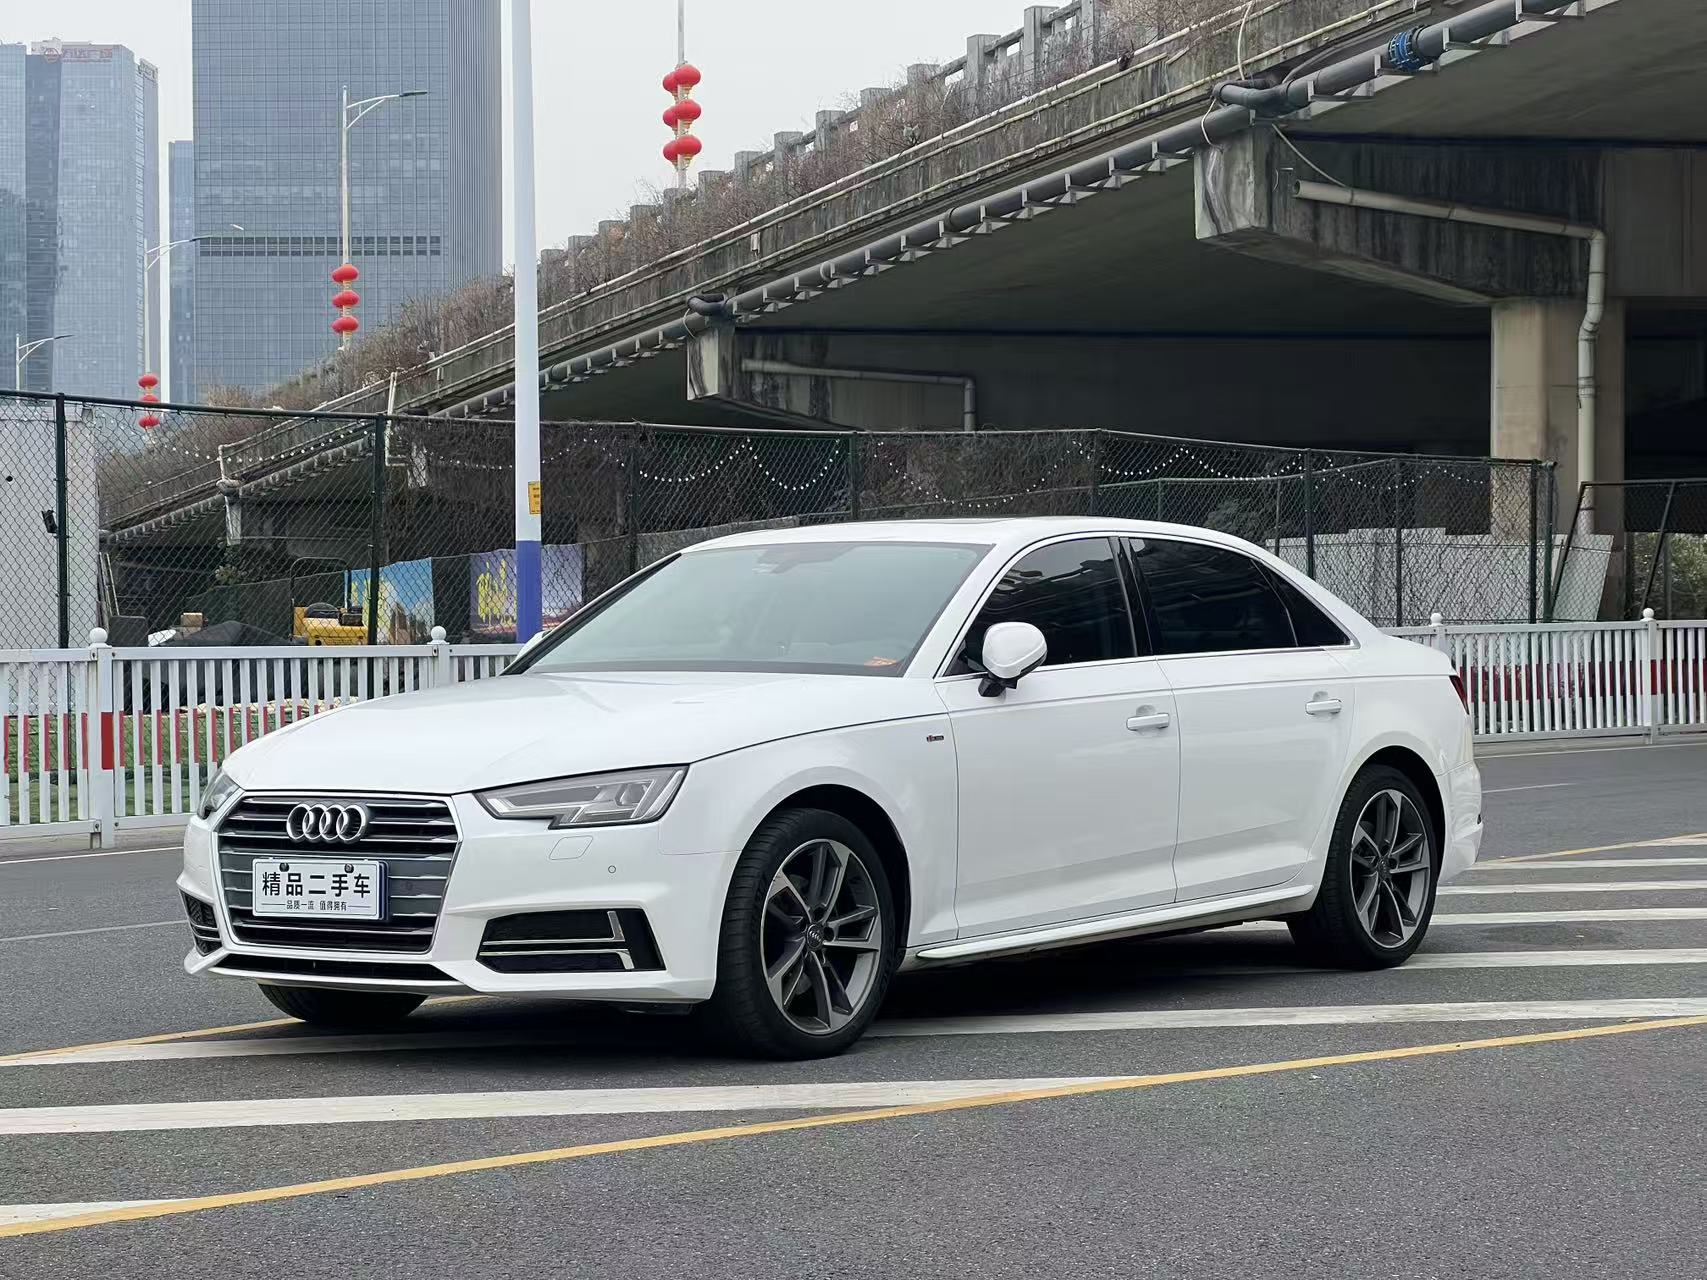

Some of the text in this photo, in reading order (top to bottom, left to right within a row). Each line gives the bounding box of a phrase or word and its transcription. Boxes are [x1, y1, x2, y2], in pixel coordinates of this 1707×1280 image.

[262, 871, 370, 898] 精品二手车
